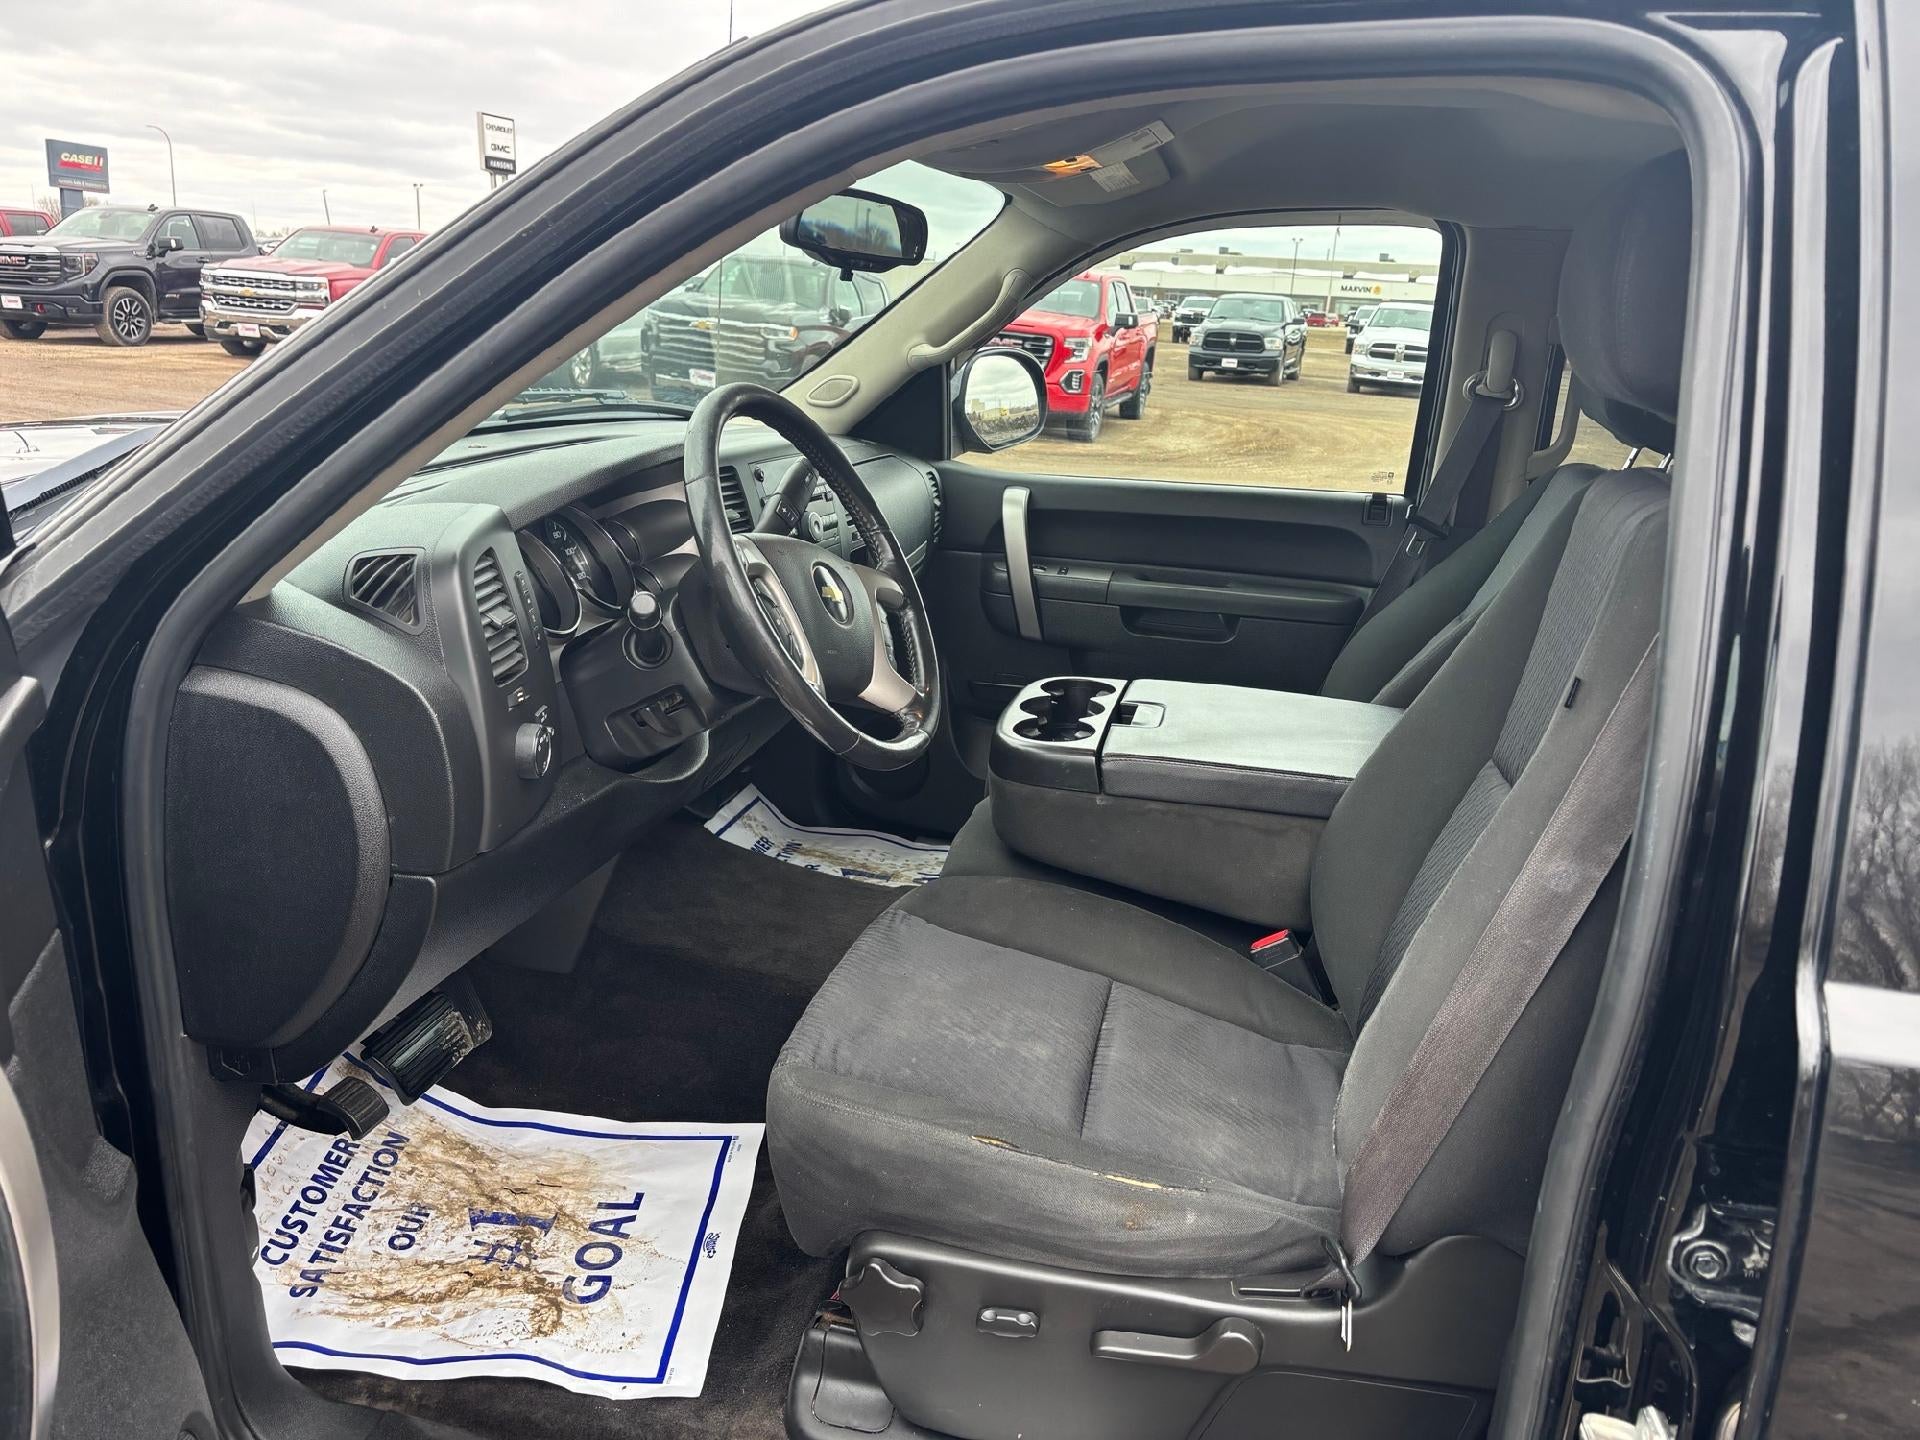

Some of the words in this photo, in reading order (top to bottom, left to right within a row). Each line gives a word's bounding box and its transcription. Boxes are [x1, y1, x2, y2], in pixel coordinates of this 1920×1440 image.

[60, 152, 94, 165] CASE
[490, 143, 512, 154] GMC
[1341, 285, 1373, 294] MARVIN
[260, 1137, 361, 1266] CUSTOMER
[289, 1131, 410, 1298] SATISFACTION
[562, 1192, 646, 1305] GOAL
